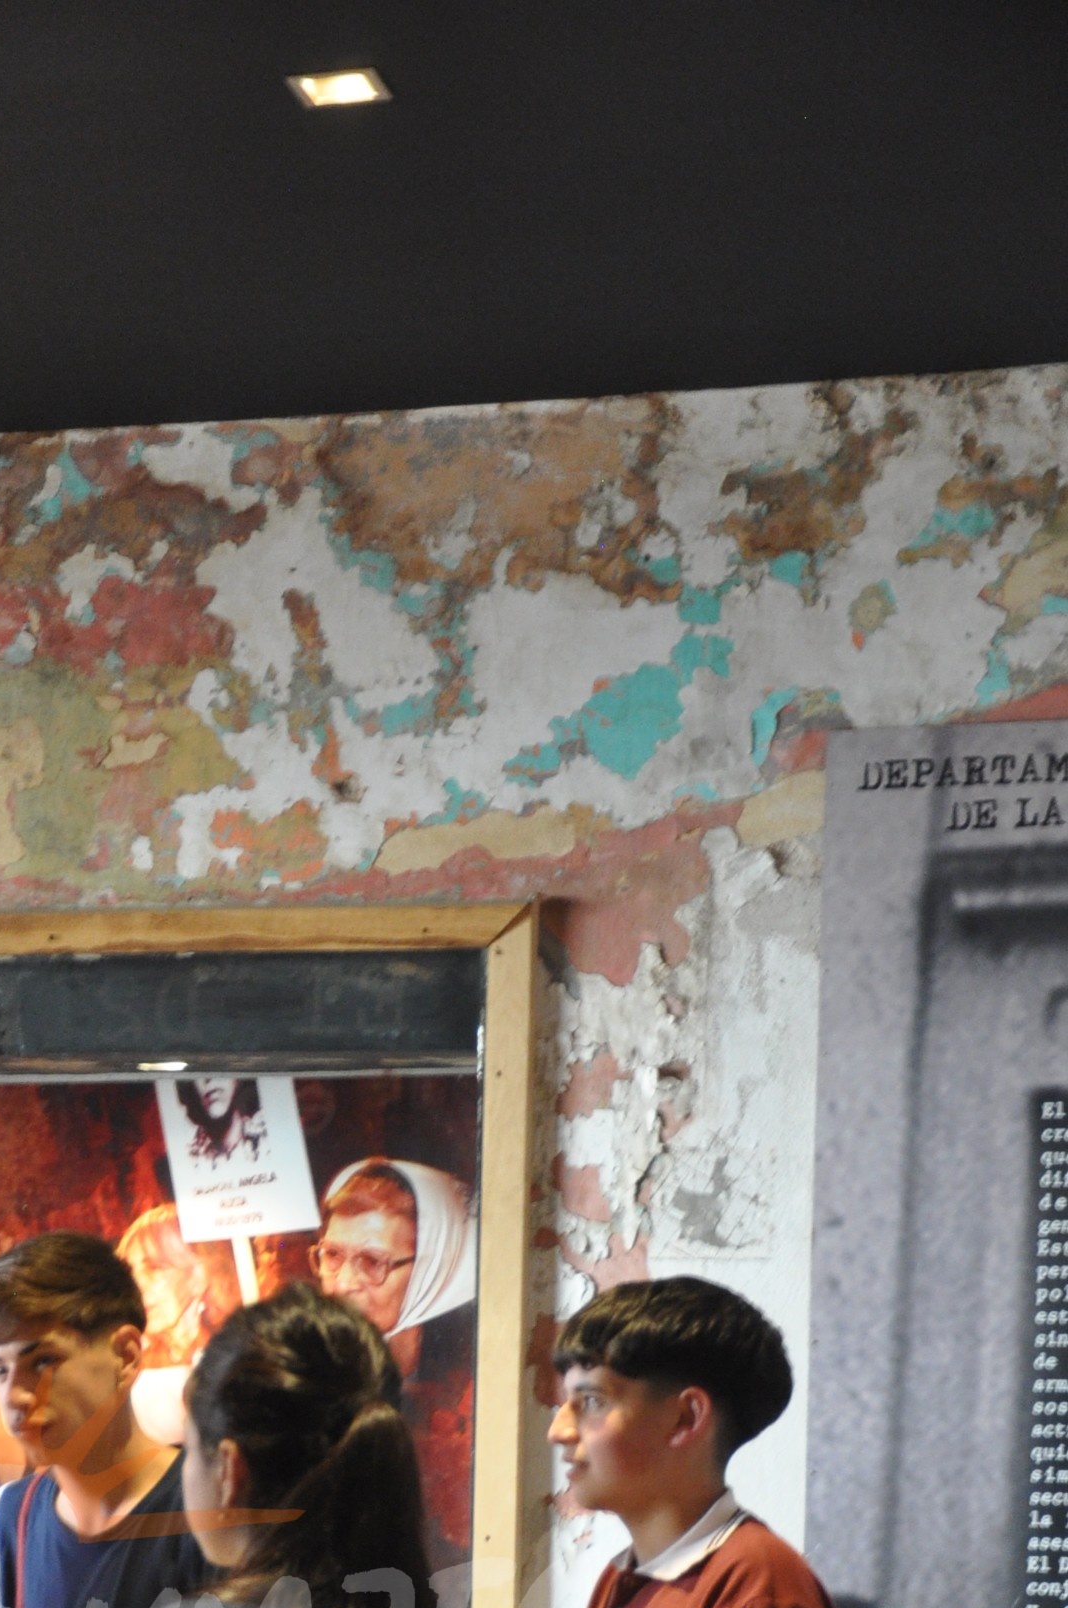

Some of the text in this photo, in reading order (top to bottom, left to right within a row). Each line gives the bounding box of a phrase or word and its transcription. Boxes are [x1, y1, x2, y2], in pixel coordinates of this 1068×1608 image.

[858, 753, 1068, 791] DEPARTAM
[945, 797, 1066, 832] DE LA
[1033, 1352, 1059, 1370] de
